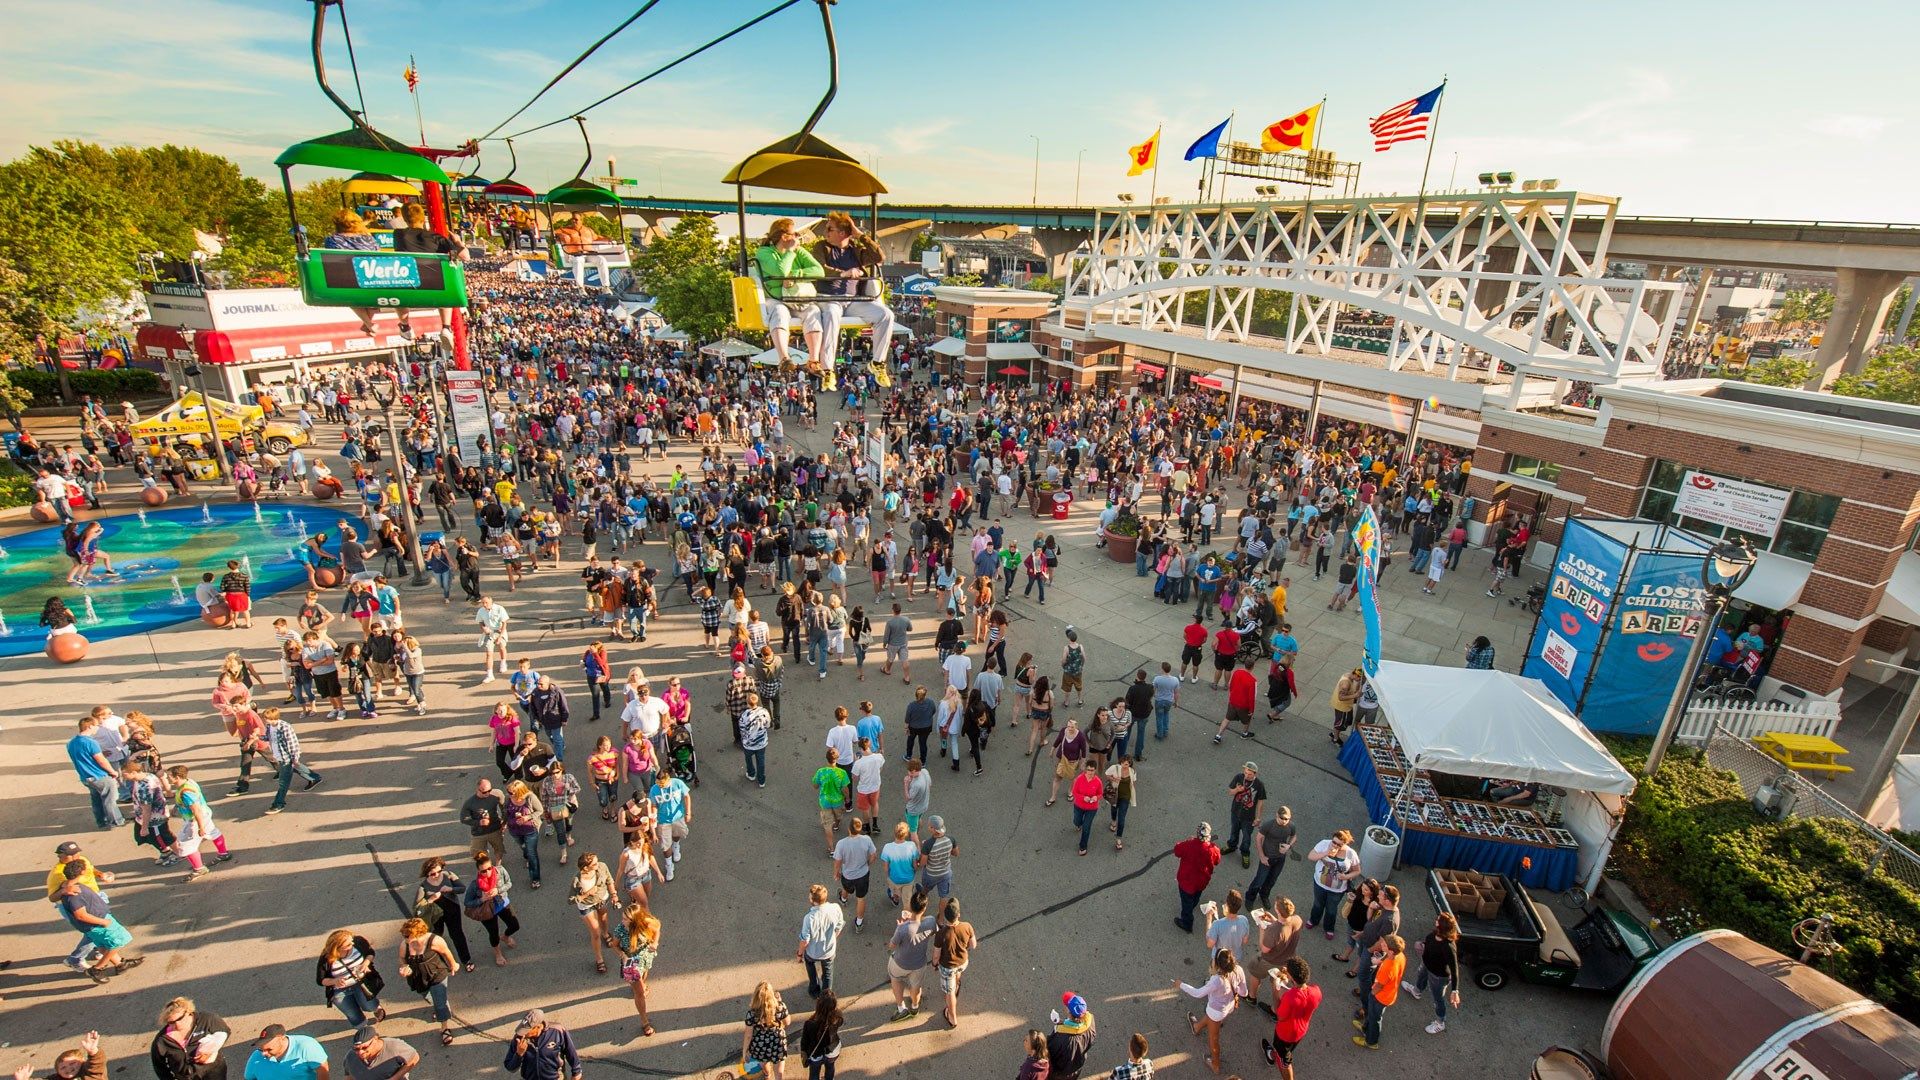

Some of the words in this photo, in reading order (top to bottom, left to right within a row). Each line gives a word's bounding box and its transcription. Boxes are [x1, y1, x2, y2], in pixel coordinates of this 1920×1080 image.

[378, 234, 394, 244] Ver
[359, 259, 410, 278] Verlo
[154, 283, 202, 297] information
[222, 304, 278, 315] JOURNAL
[377, 297, 400, 306] 89
[1568, 552, 1606, 582] LOST
[1558, 562, 1611, 598] CHILDREN'S
[1554, 580, 1599, 618] AREA
[1640, 584, 1704, 600] LOST
[1626, 596, 1705, 611] CHILDREN
[1626, 616, 1700, 634] AREA
